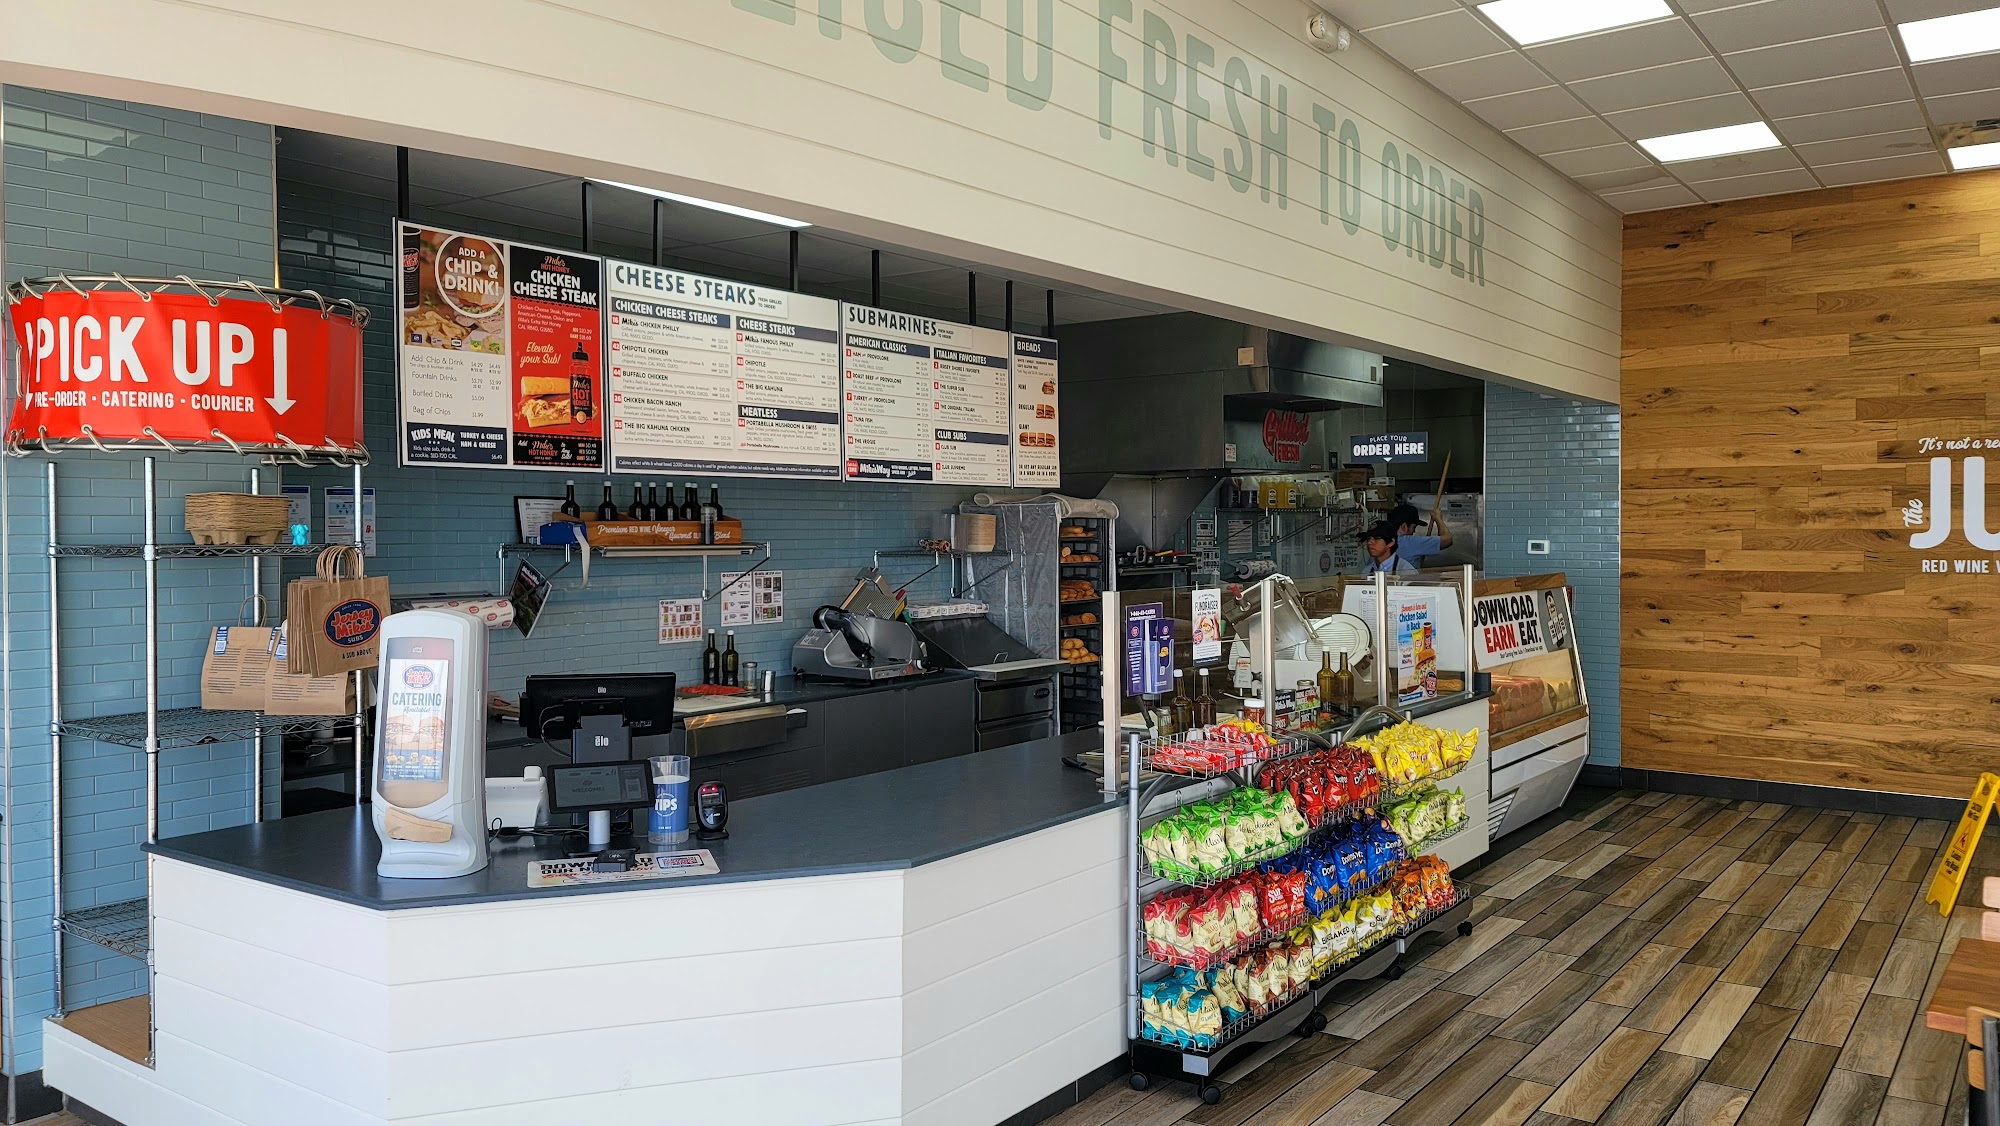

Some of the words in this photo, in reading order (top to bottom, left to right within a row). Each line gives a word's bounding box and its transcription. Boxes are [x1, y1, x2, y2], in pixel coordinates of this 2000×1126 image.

[1098, 0, 1288, 211] FRESH
[1312, 102, 1360, 236] TO
[1380, 140, 1485, 288] ORDER
[459, 247, 476, 257] ADD
[480, 251, 485, 259] A
[445, 257, 482, 275] CHIP
[488, 264, 498, 279] &
[552, 264, 570, 274] HONEY
[444, 274, 499, 296] DRINK!
[531, 269, 580, 289] CHICKEN
[615, 265, 685, 294] CHEESE
[694, 279, 756, 306] STEAKS
[514, 281, 557, 300] CHEESE
[561, 288, 596, 305] STEAK
[616, 300, 653, 315] CHICKEN
[656, 306, 686, 320] CHEESE
[689, 311, 718, 324] STEAKS
[740, 319, 767, 332] CHEESE
[769, 323, 795, 336] STEAKS
[849, 306, 937, 336] SUBMARINES
[36, 316, 148, 383] PICK
[172, 318, 254, 386] UP
[526, 342, 554, 353] Elevate
[622, 344, 646, 354] CHIPOTLE
[648, 348, 669, 356] CHICKEN
[849, 336, 880, 348] AMERICAN
[882, 342, 907, 352] CLASSICS
[1017, 340, 1041, 352] BREADS
[426, 356, 440, 364] Chip
[448, 358, 464, 366] Drink
[520, 355, 541, 368] your
[542, 354, 561, 364] Sub!
[936, 350, 958, 360] ITALIAN
[959, 353, 987, 364] FAVORITES
[412, 371, 438, 380] Fountain
[35, 390, 86, 407] PRE-ORDER
[102, 390, 174, 409] CATERING
[191, 394, 254, 412] COURIER
[412, 389, 433, 397] Bottled
[435, 391, 453, 399] Drinks
[572, 389, 590, 400] HOT
[412, 406, 424, 415] Bag
[434, 408, 451, 416] Chips
[742, 406, 778, 418] MEATLESS
[411, 428, 432, 441] KIDS
[433, 428, 455, 443] MEAL
[937, 431, 952, 439] CLUB
[953, 432, 967, 440] SUBS
[1370, 435, 1388, 443] PLACE
[1353, 444, 1391, 456] ORDER
[1395, 443, 1425, 455] HERE
[1918, 436, 1943, 453] It's
[1946, 436, 1970, 450] not
[1972, 440, 1982, 449] a
[1902, 499, 1924, 527] the
[597, 525, 628, 534] Premium
[652, 523, 675, 536] Vinegar
[669, 532, 692, 541] Gourmet
[1922, 559, 1948, 573] RED
[1954, 560, 1989, 573] WINE
[1195, 600, 1218, 611] FUNDRAISER
[1474, 595, 1537, 627] DOWNLOAD.
[331, 608, 374, 626] Jersey
[1400, 612, 1415, 622] Chicken
[1416, 610, 1427, 619] Salad
[335, 621, 374, 640] Mike's
[1410, 621, 1420, 631] Back
[348, 635, 363, 643] SUBS
[1484, 623, 1519, 654] EARN.
[1518, 620, 1541, 646] EAT.
[357, 648, 372, 657] ABOVE
[392, 692, 442, 706] CATERING
[655, 798, 677, 811] TIPS
